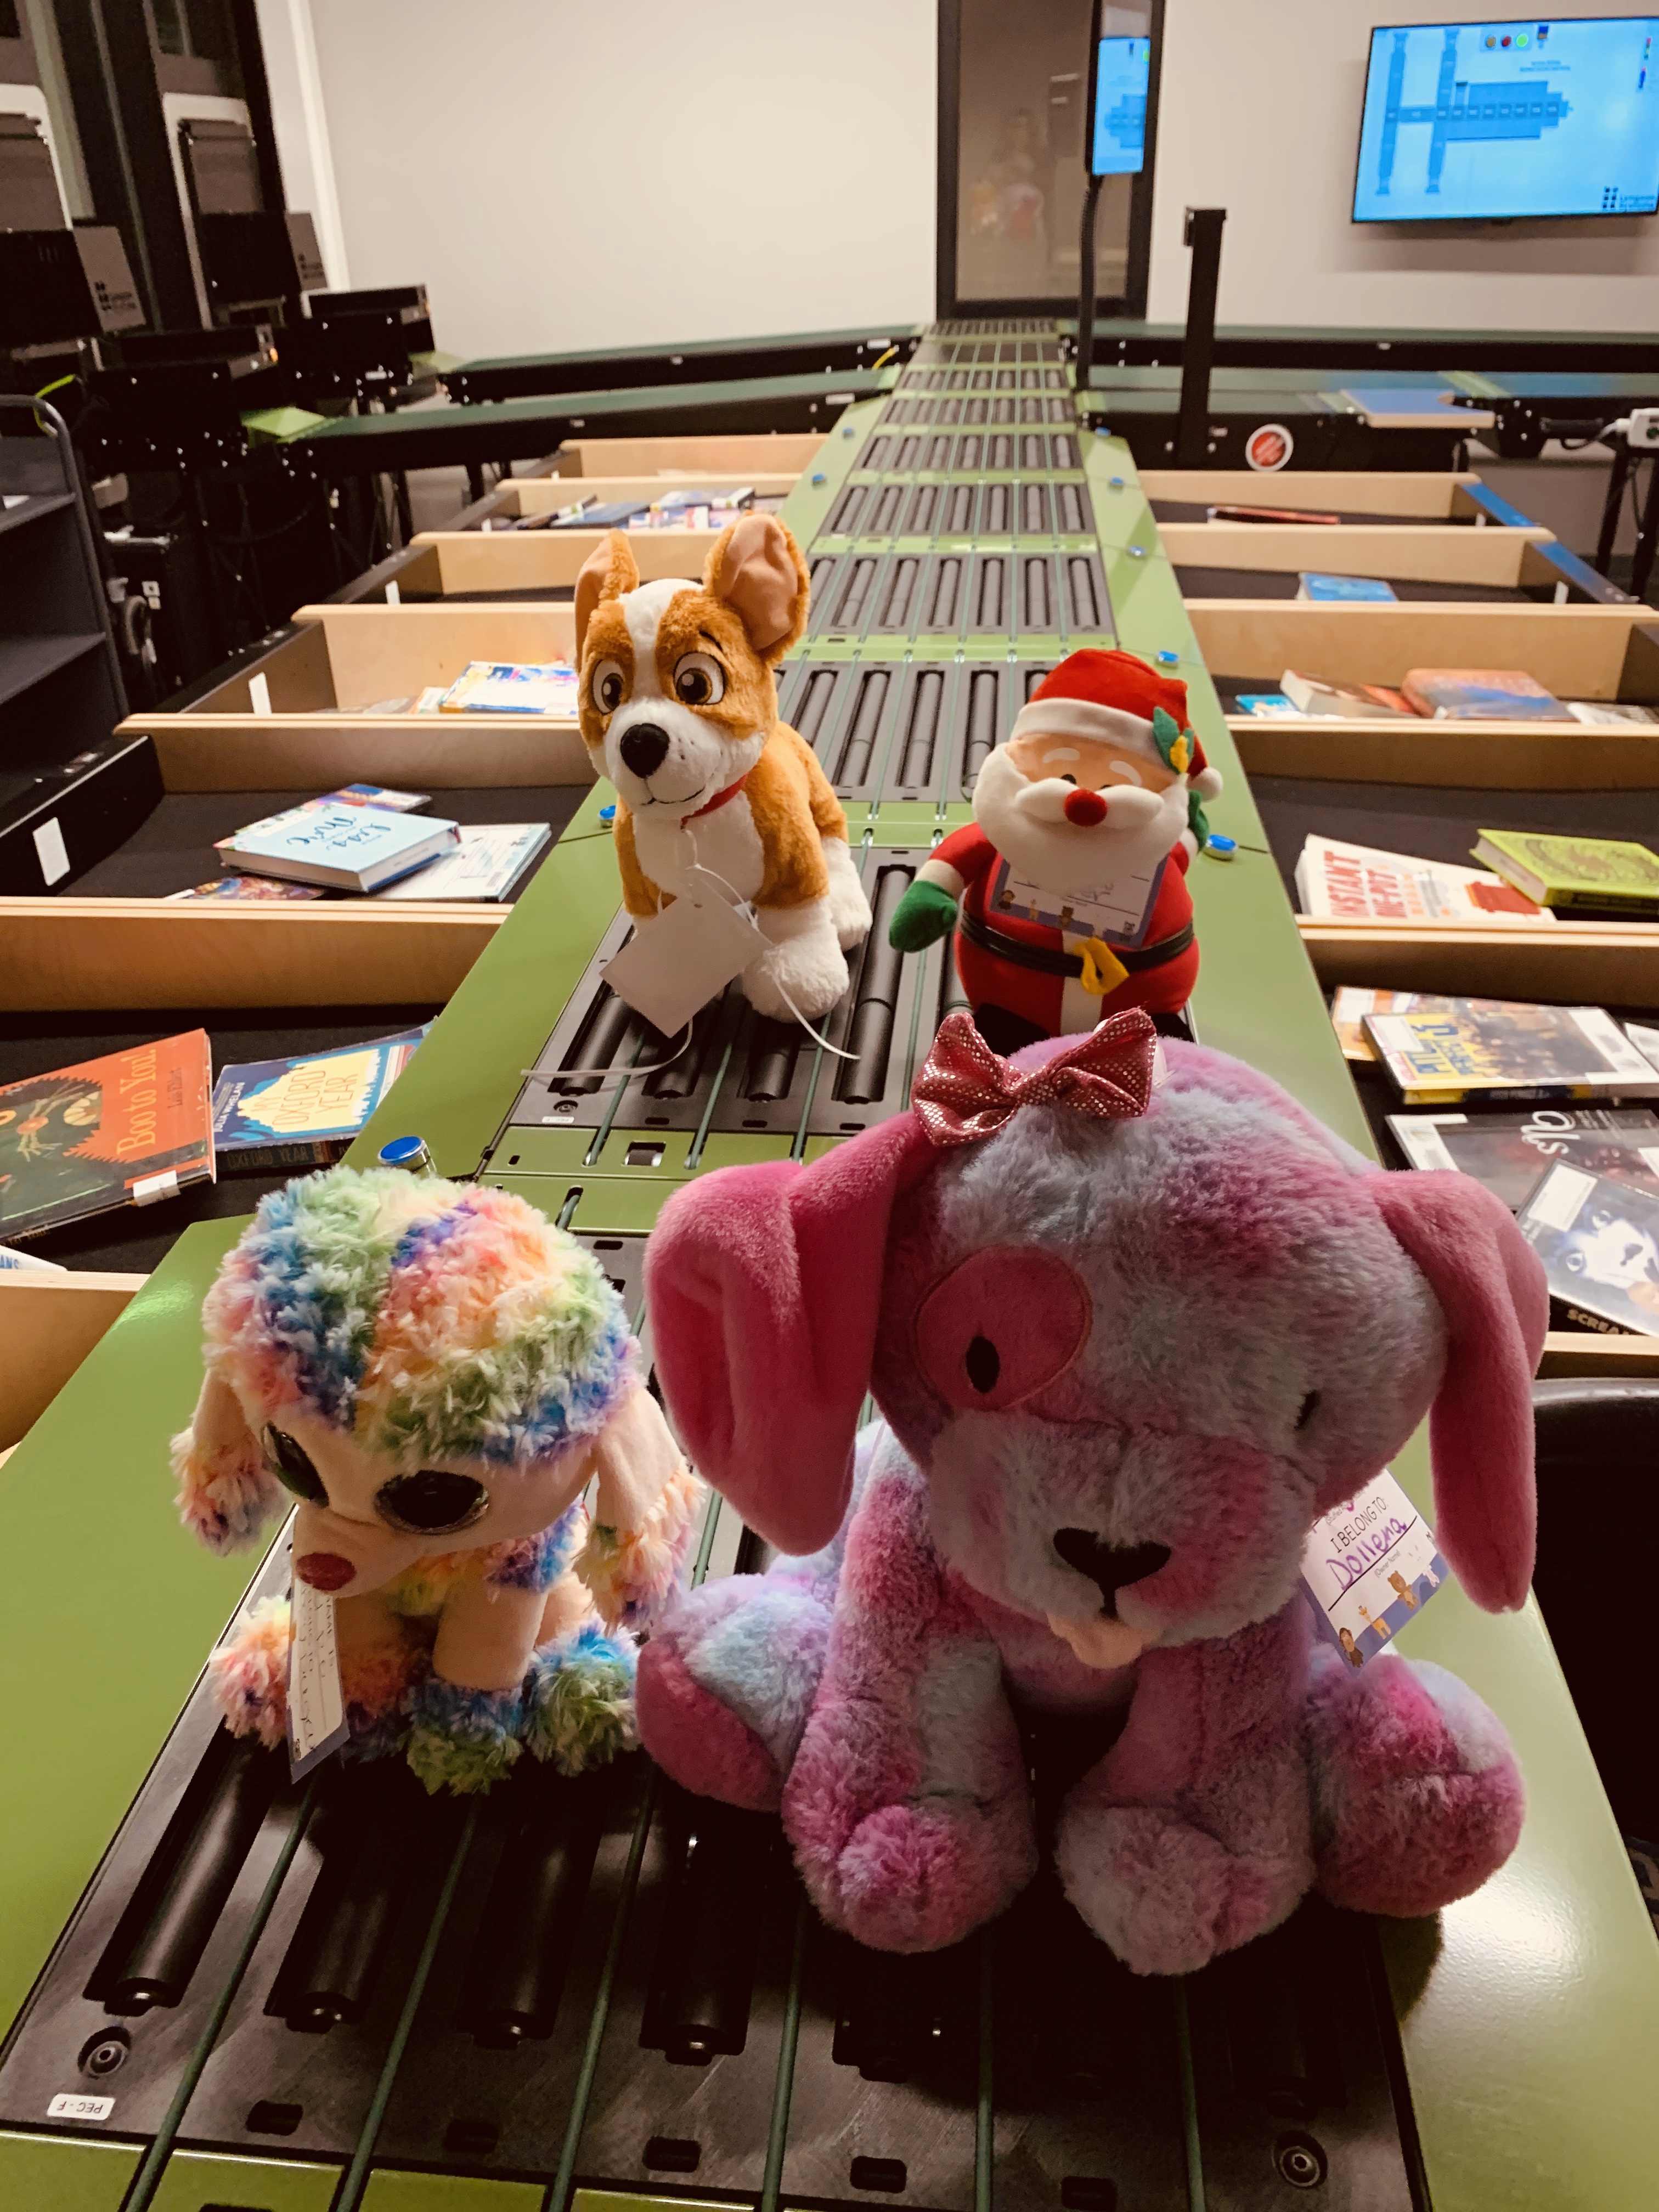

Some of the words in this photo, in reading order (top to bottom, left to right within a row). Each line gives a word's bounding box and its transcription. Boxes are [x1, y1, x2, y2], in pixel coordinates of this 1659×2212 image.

[119, 1049, 156, 1094] You!
[122, 1089, 156, 1112] to
[222, 1082, 245, 1115] WHELAN
[252, 1097, 280, 1112] MY
[272, 1070, 325, 1125] OXFORD
[315, 1074, 358, 1114] YEAR
[116, 1110, 156, 1154] Boo
[1330, 1538, 1341, 1553] I
[1338, 1506, 1378, 1547] BELONG
[57, 2101, 67, 2111] F
[76, 2102, 104, 2114] PEC
